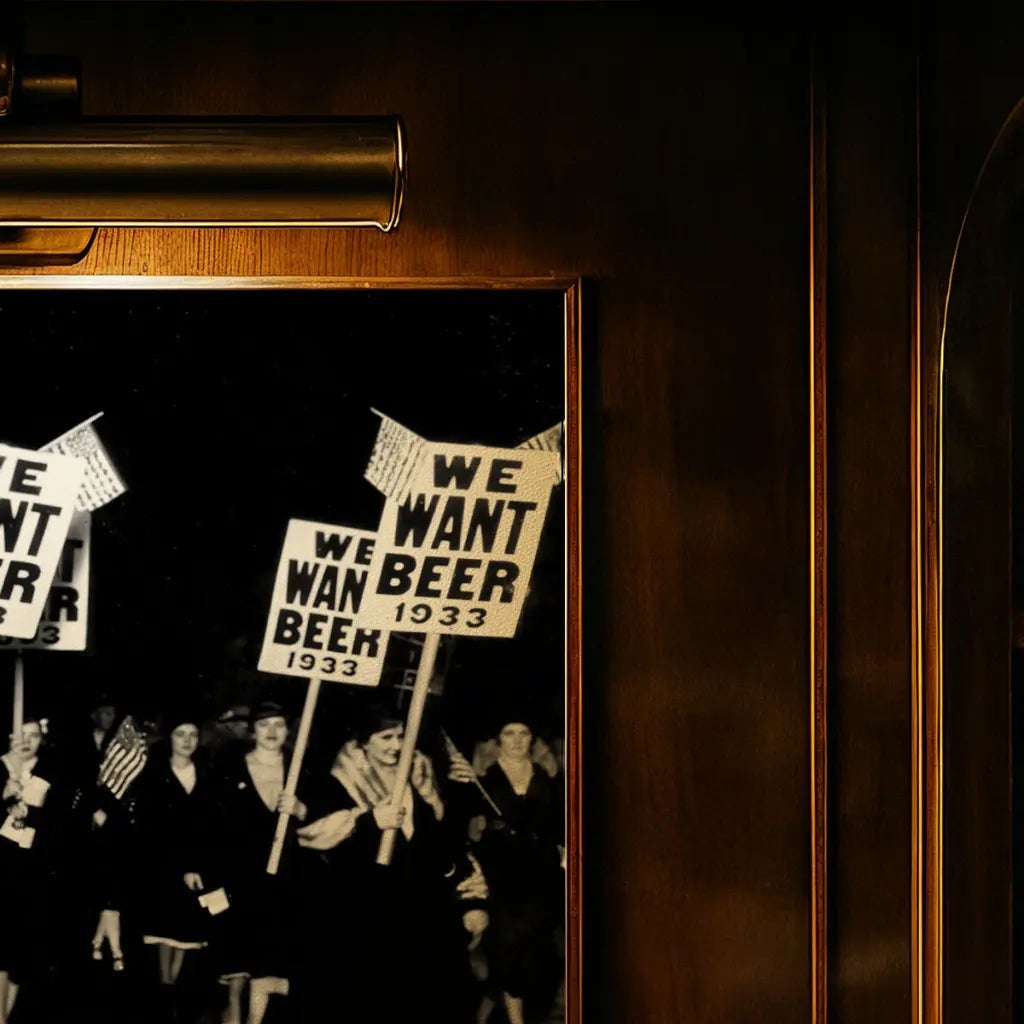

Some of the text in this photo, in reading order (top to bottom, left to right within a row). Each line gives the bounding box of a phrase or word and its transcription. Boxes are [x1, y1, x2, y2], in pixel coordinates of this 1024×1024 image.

[433, 454, 523, 494] WE
[394, 492, 537, 554] WANT
[315, 530, 376, 566] WE
[285, 558, 369, 614] WAN
[376, 552, 520, 604] BEER
[273, 608, 381, 658] BEER
[395, 602, 487, 628] 1933
[287, 651, 358, 676] 1933
